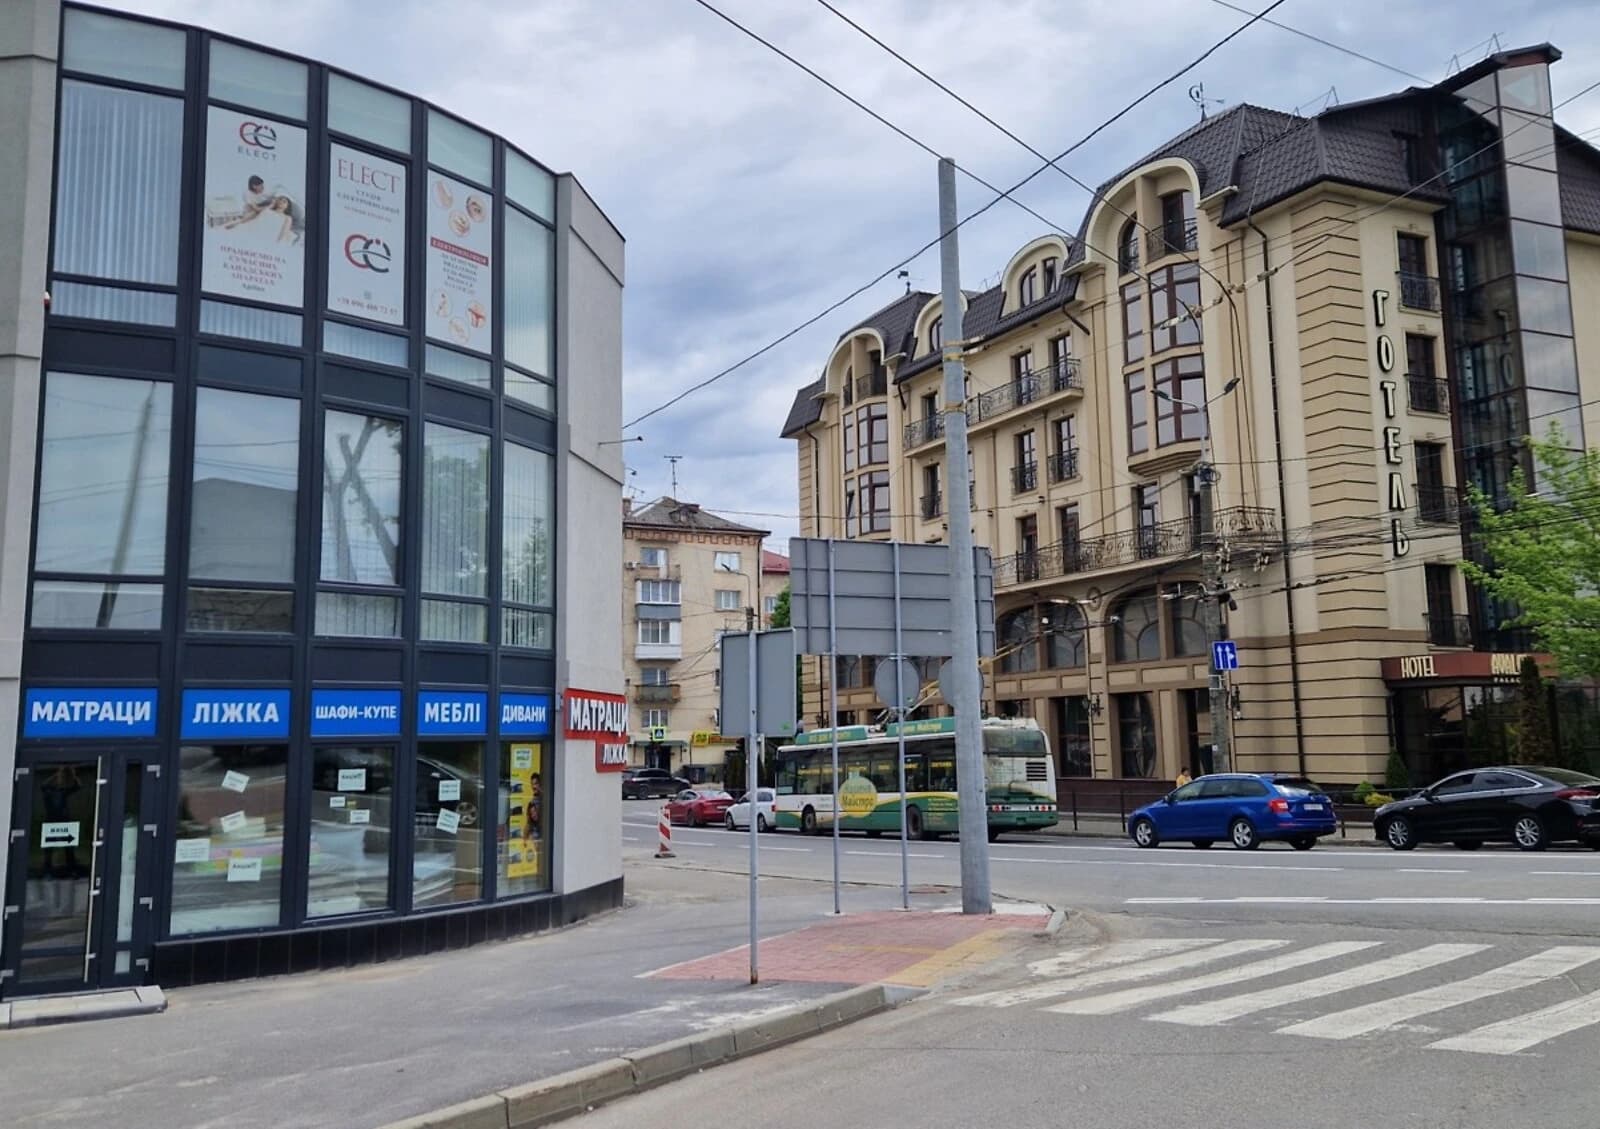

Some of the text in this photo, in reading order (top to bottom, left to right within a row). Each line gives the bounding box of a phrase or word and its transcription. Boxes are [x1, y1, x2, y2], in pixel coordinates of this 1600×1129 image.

[238, 145, 277, 160] ELECT
[337, 158, 401, 194] ELECT
[1372, 290, 1410, 558] ГОТЕЛЬ
[1400, 655, 1439, 678] HOTEL
[32, 701, 151, 725] МАТРАЦИ
[192, 702, 280, 723] ЛІЖКА
[315, 704, 397, 719] ШАФИ-КУПЕ
[424, 702, 481, 723] МЕБЛІ
[502, 704, 546, 724] ДИВАНИ
[570, 697, 629, 737] МАТРАЦИ
